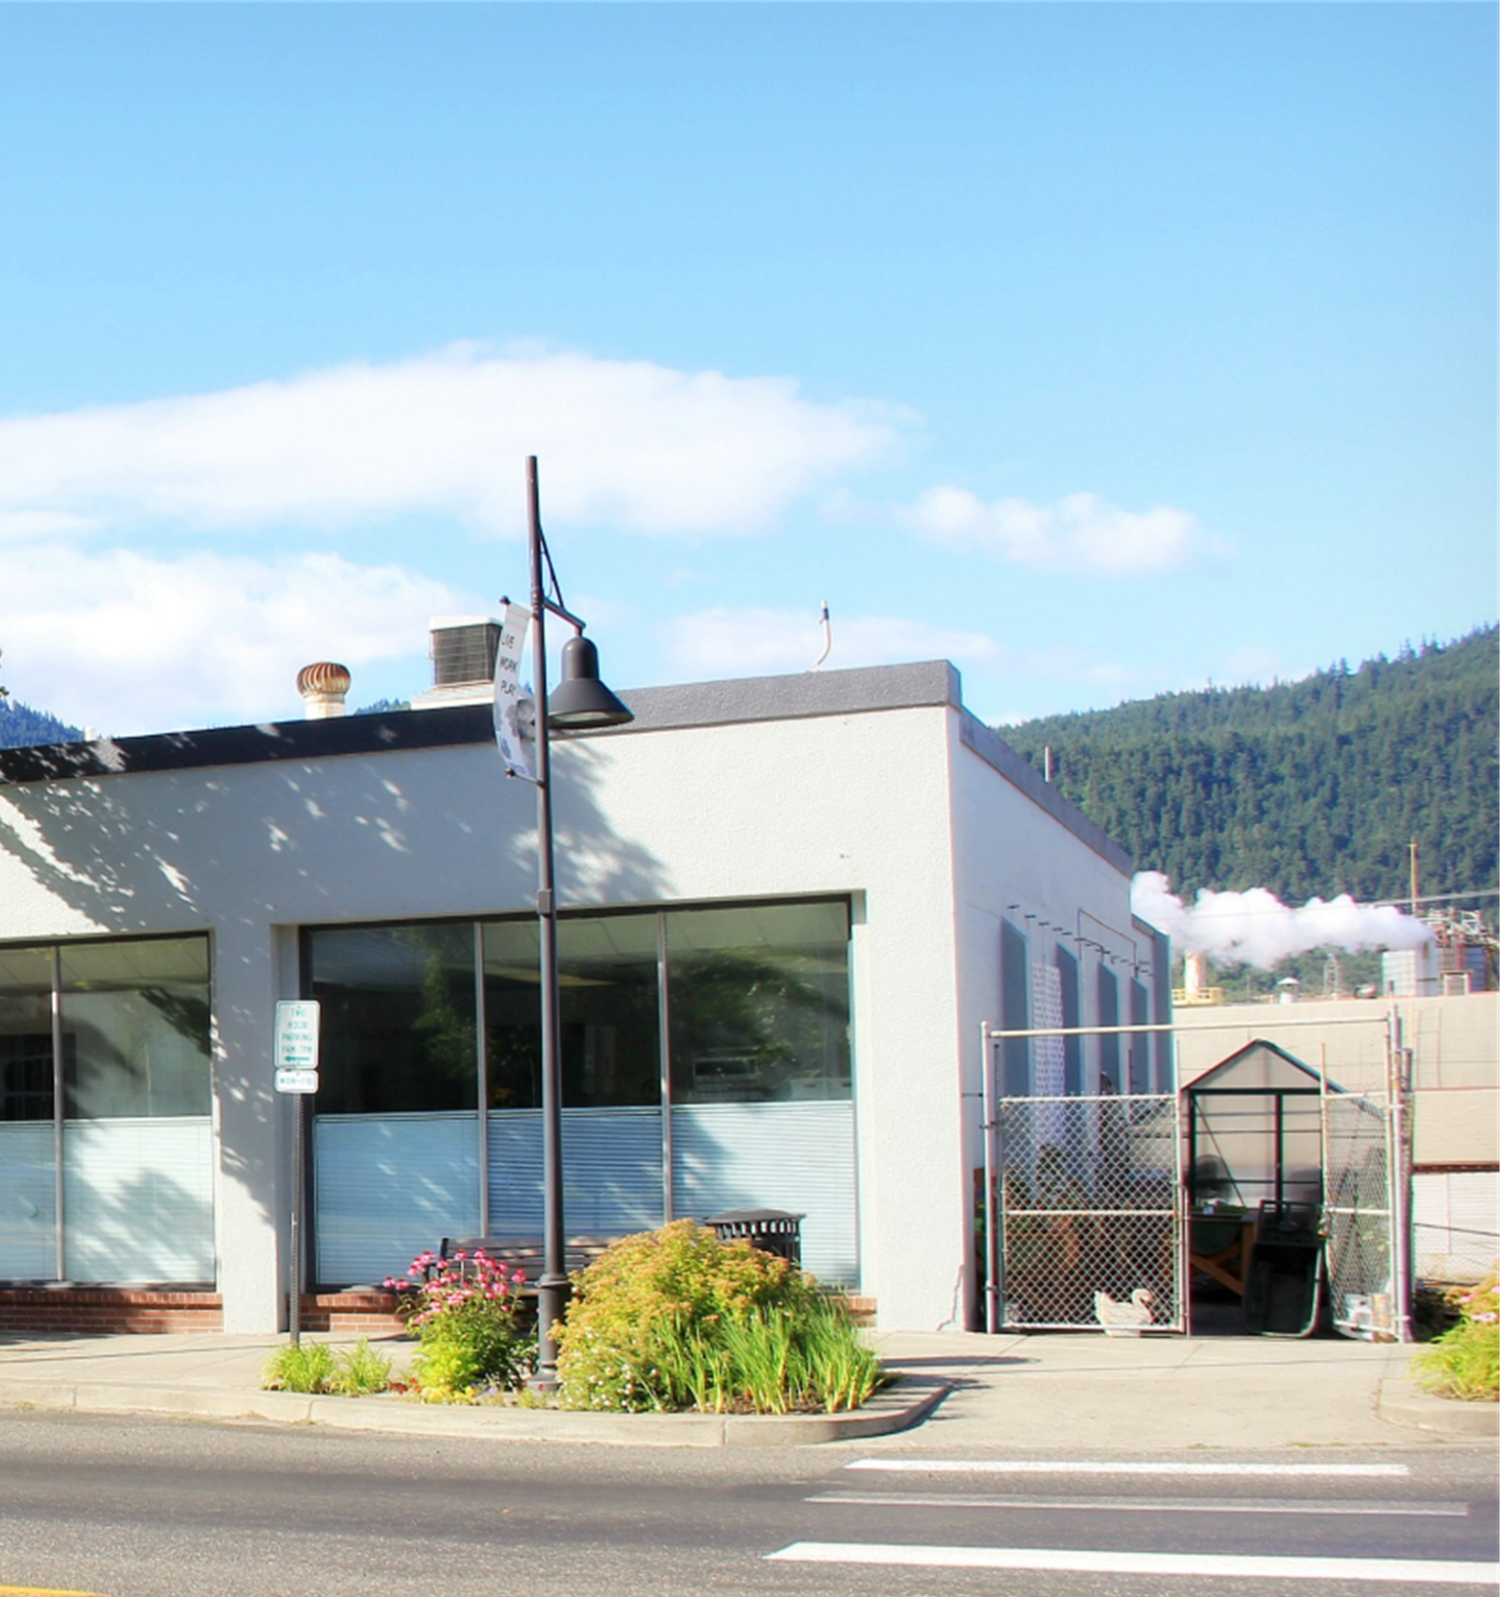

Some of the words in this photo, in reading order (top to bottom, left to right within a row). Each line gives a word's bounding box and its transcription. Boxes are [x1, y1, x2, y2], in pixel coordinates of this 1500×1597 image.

[501, 634, 515, 649] LIVE
[500, 655, 517, 675] WORK
[500, 679, 517, 697] PLAY
